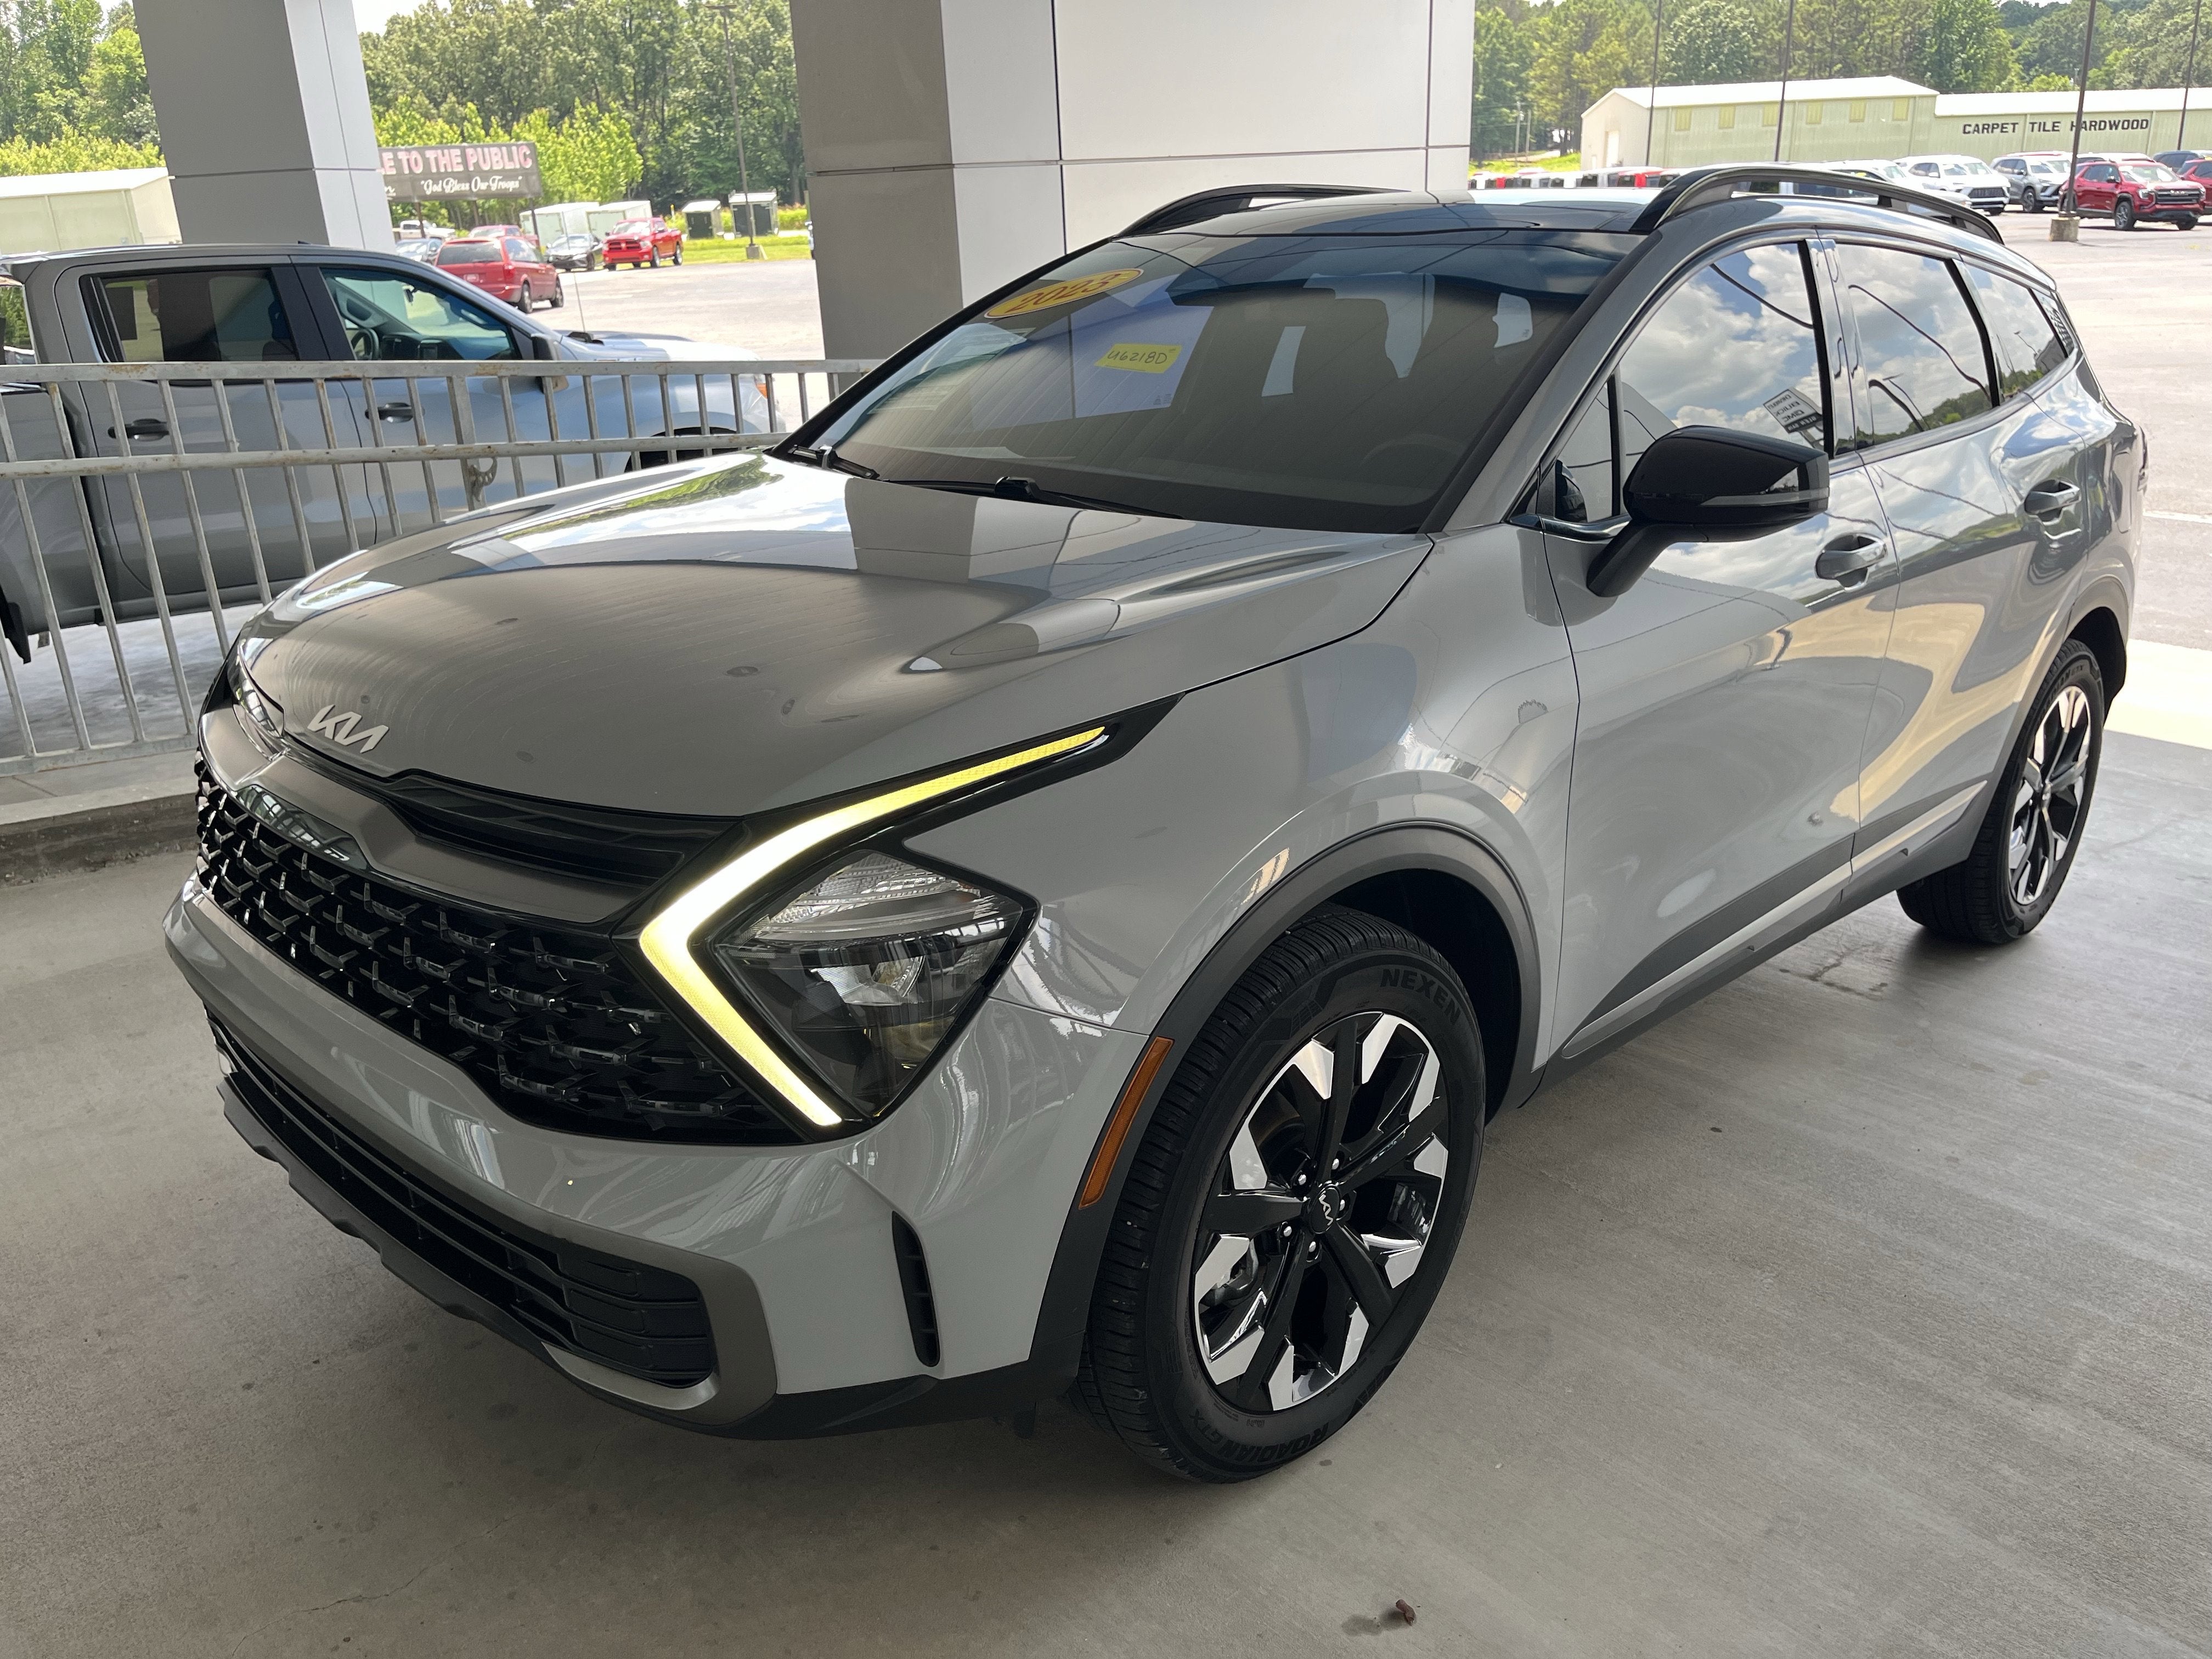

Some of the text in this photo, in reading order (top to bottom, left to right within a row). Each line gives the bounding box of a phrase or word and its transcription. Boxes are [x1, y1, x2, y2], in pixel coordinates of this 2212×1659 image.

[1962, 119, 2149, 134] CARPET TILE HARDWOOD
[397, 150, 424, 174] TO
[425, 148, 464, 173] THE
[465, 145, 533, 171] PUBLIC
[443, 177, 470, 194] Bless
[471, 176, 489, 193] Our
[1004, 273, 1122, 313] 2023
[307, 703, 390, 754] KIA
[1380, 968, 1463, 1025] NEXEN
[1188, 1409, 1220, 1445] GTX
[1217, 1422, 1329, 1463] ROADIAN
